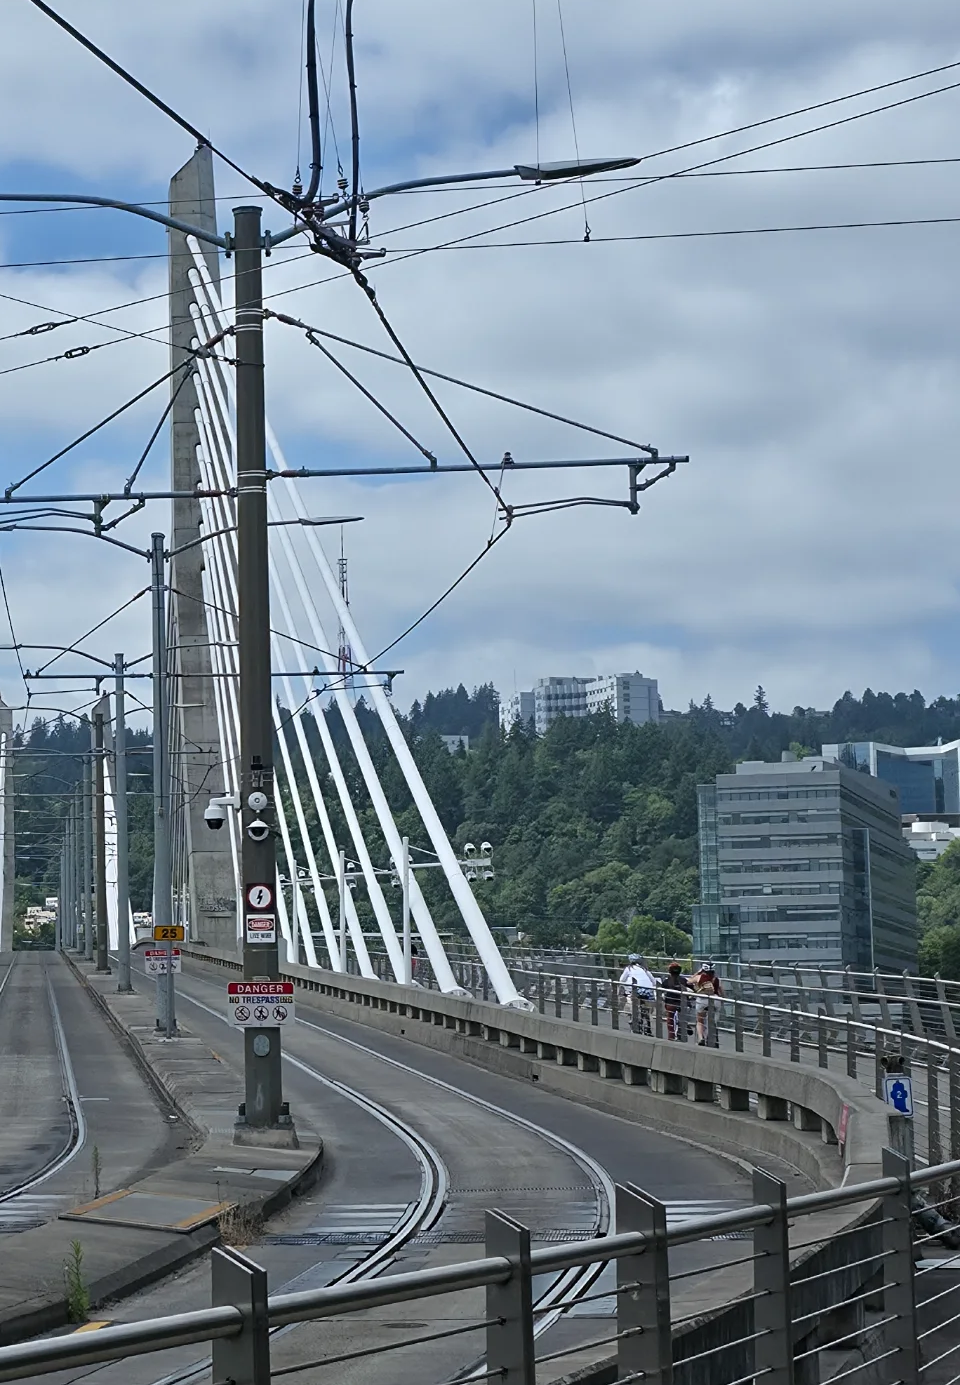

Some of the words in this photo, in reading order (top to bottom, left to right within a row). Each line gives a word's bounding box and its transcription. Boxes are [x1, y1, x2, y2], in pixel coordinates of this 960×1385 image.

[161, 928, 177, 938] 25
[237, 984, 284, 993] DANGER
[228, 996, 240, 1004] NO
[241, 996, 294, 1004] TRESPASSING
[896, 1090, 903, 1099] 2
